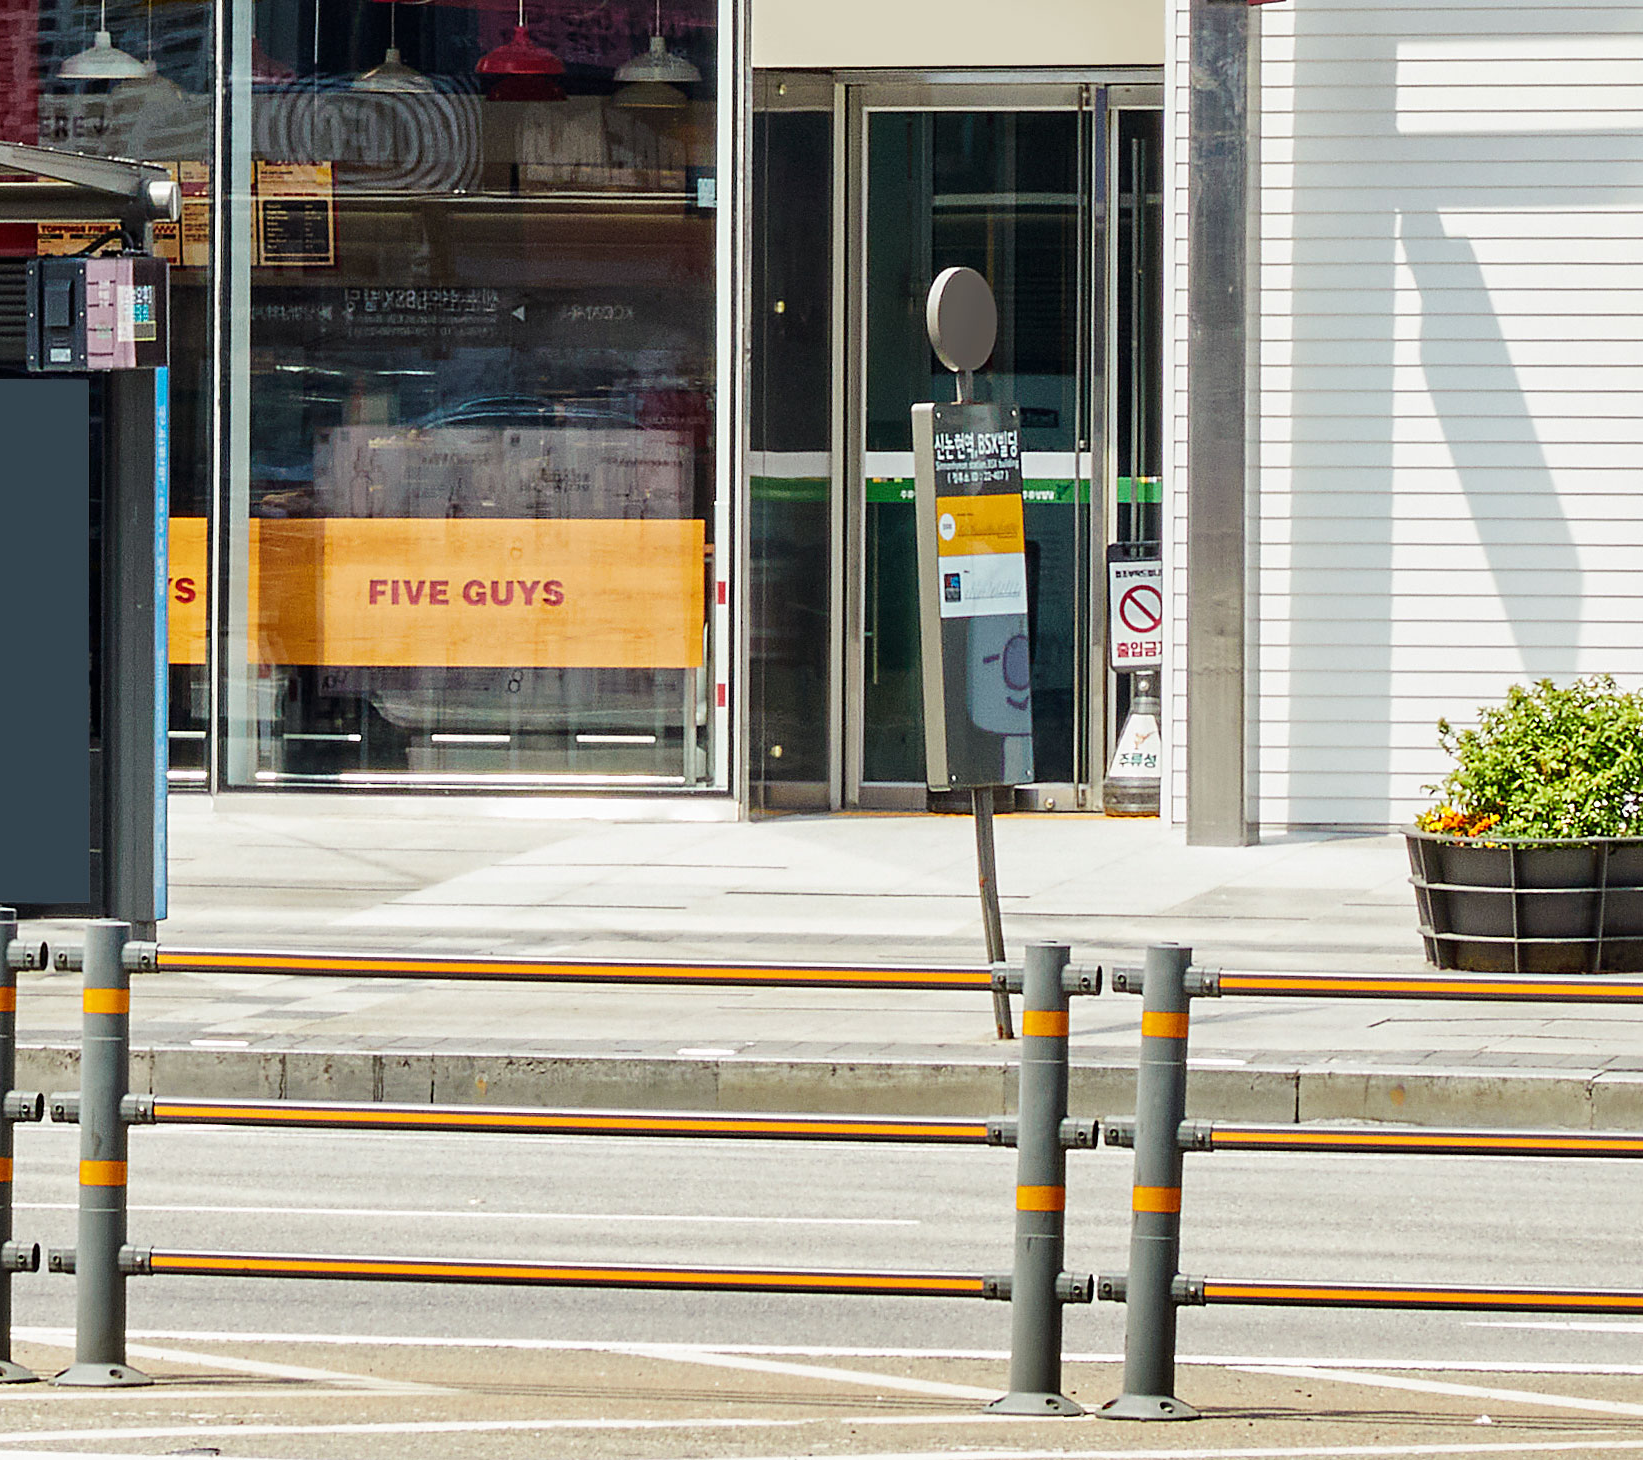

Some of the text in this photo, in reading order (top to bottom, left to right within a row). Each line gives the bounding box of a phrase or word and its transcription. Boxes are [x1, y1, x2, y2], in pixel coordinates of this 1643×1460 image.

[368, 578, 566, 607] FIVE GUYS
[1118, 753, 1158, 769] 주류성
